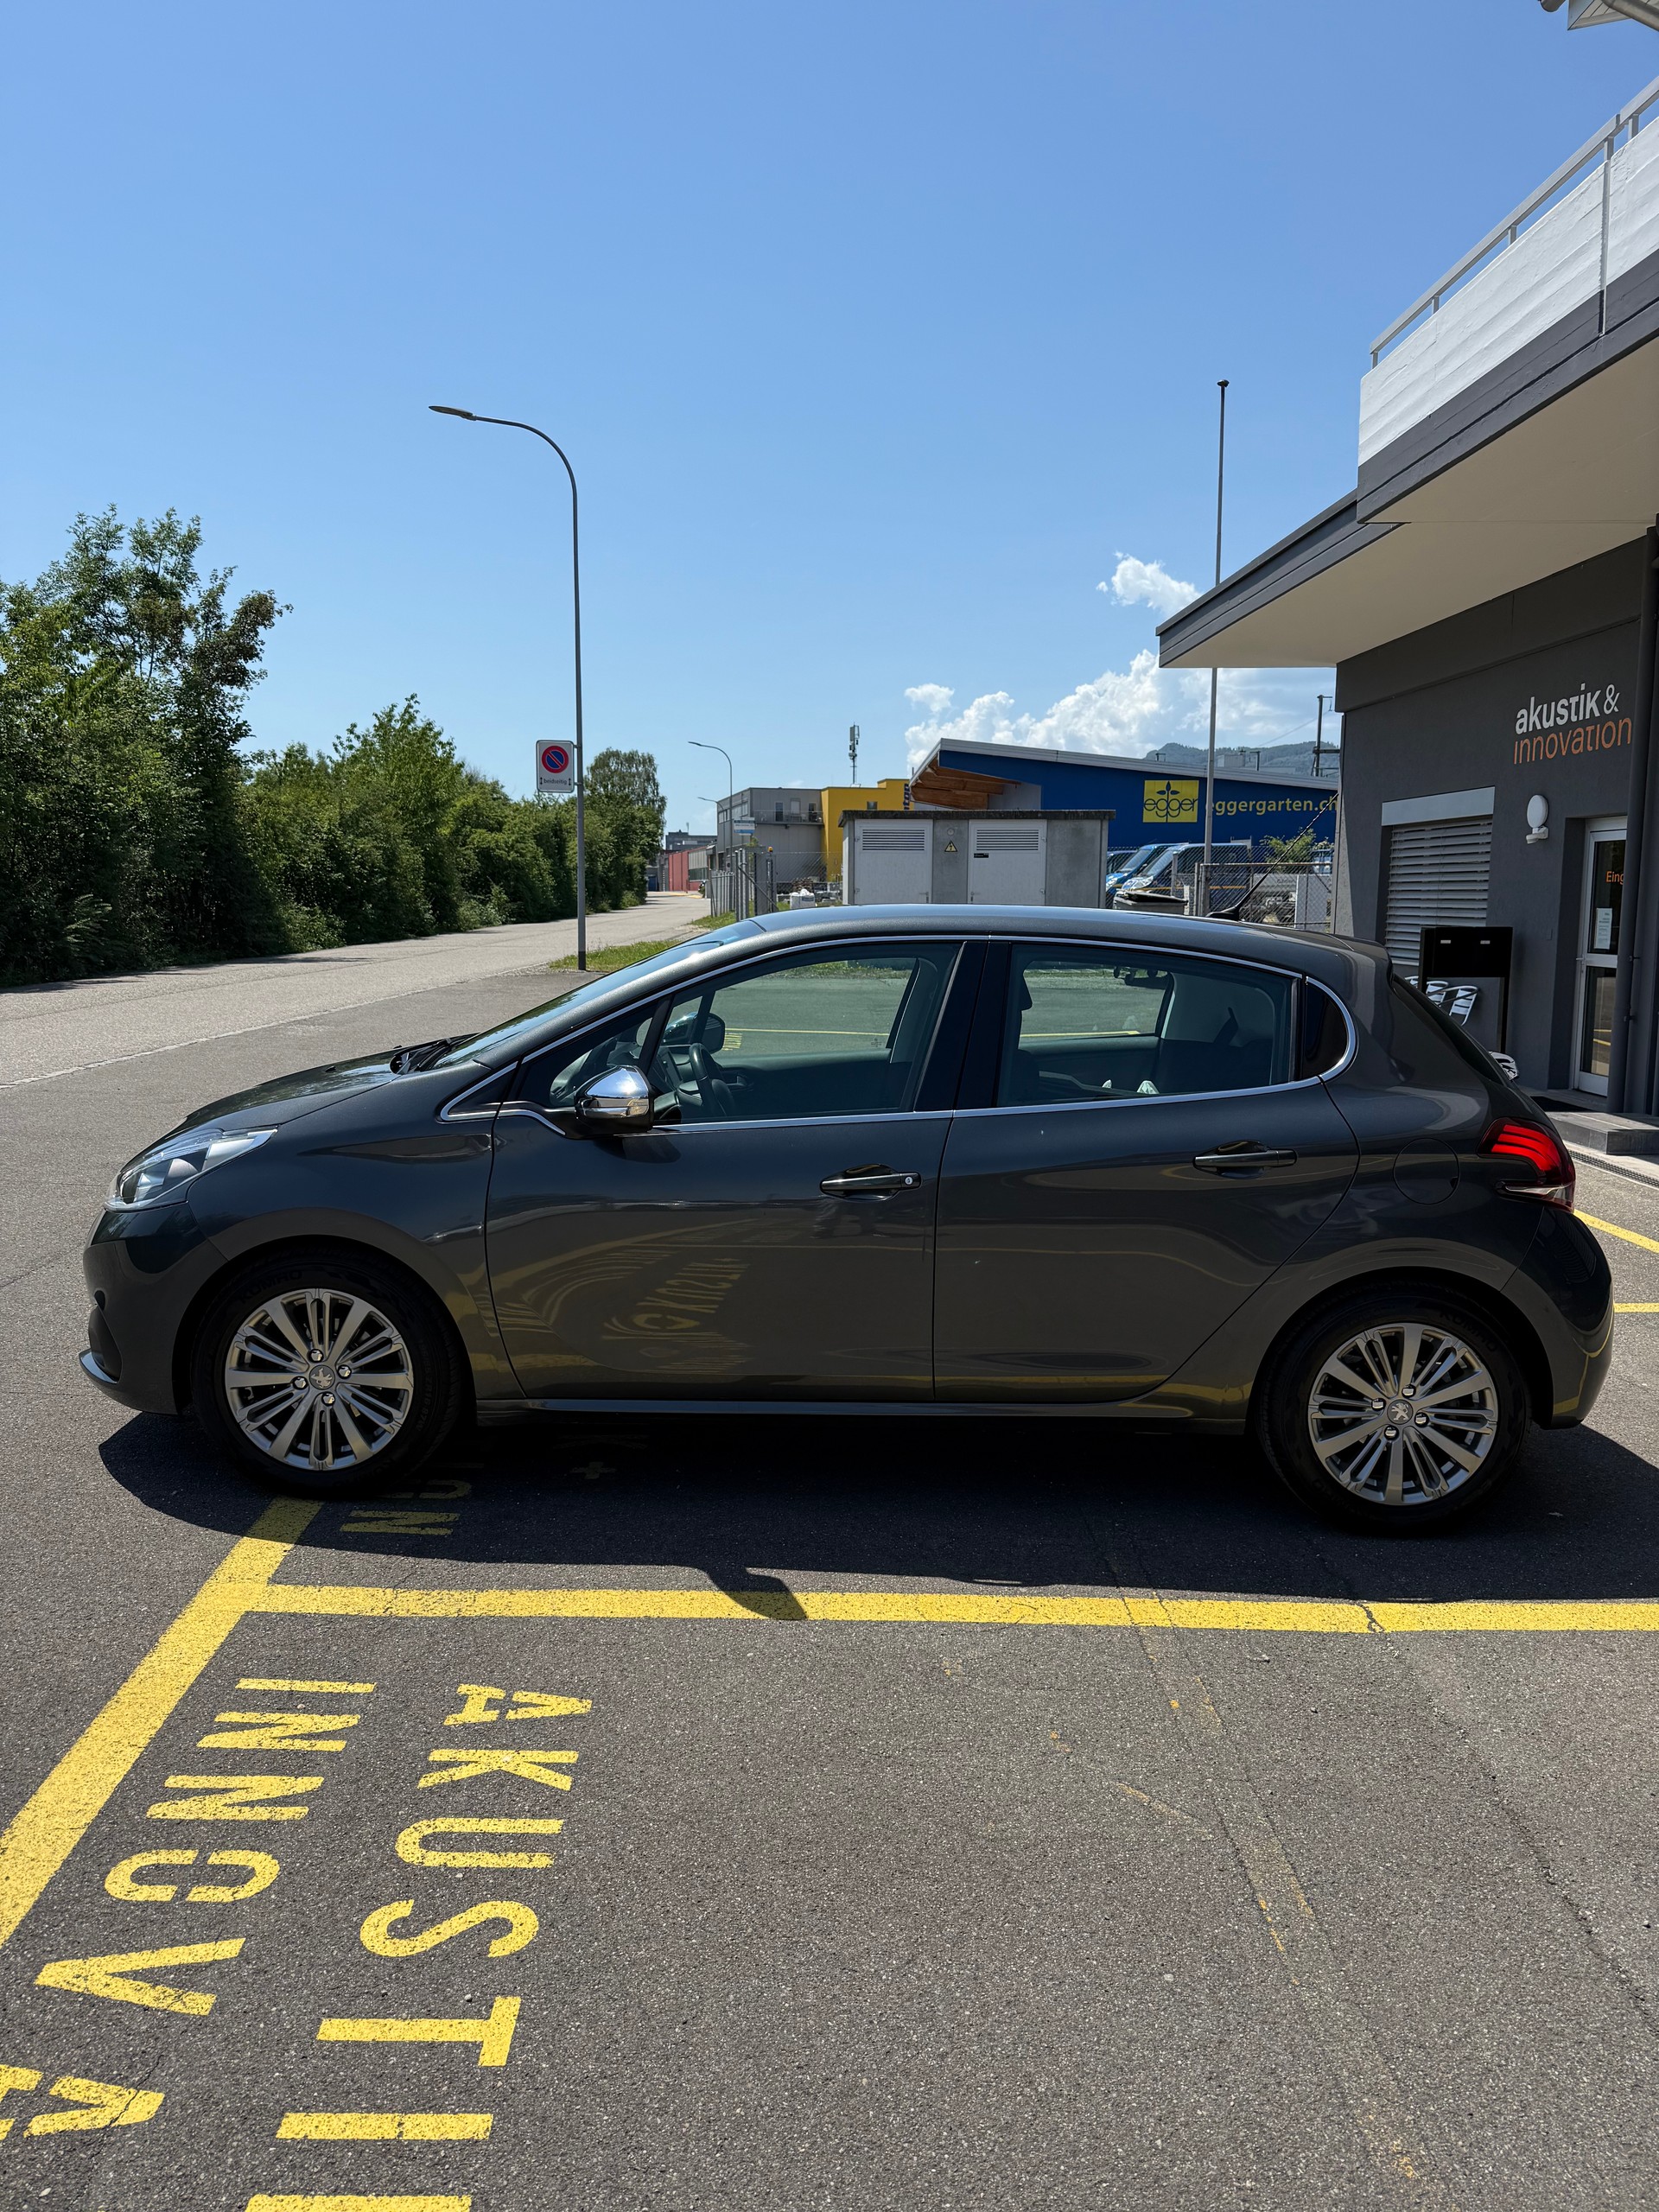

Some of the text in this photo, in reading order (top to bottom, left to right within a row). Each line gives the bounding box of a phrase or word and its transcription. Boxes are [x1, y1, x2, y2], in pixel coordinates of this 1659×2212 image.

[1515, 683, 1621, 735] akustik &
[1513, 716, 1632, 765] innovation
[1143, 797, 1198, 818] egger
[237, 1268, 303, 1305] KUMHO
[246, 1683, 593, 2212] AKUSTI
